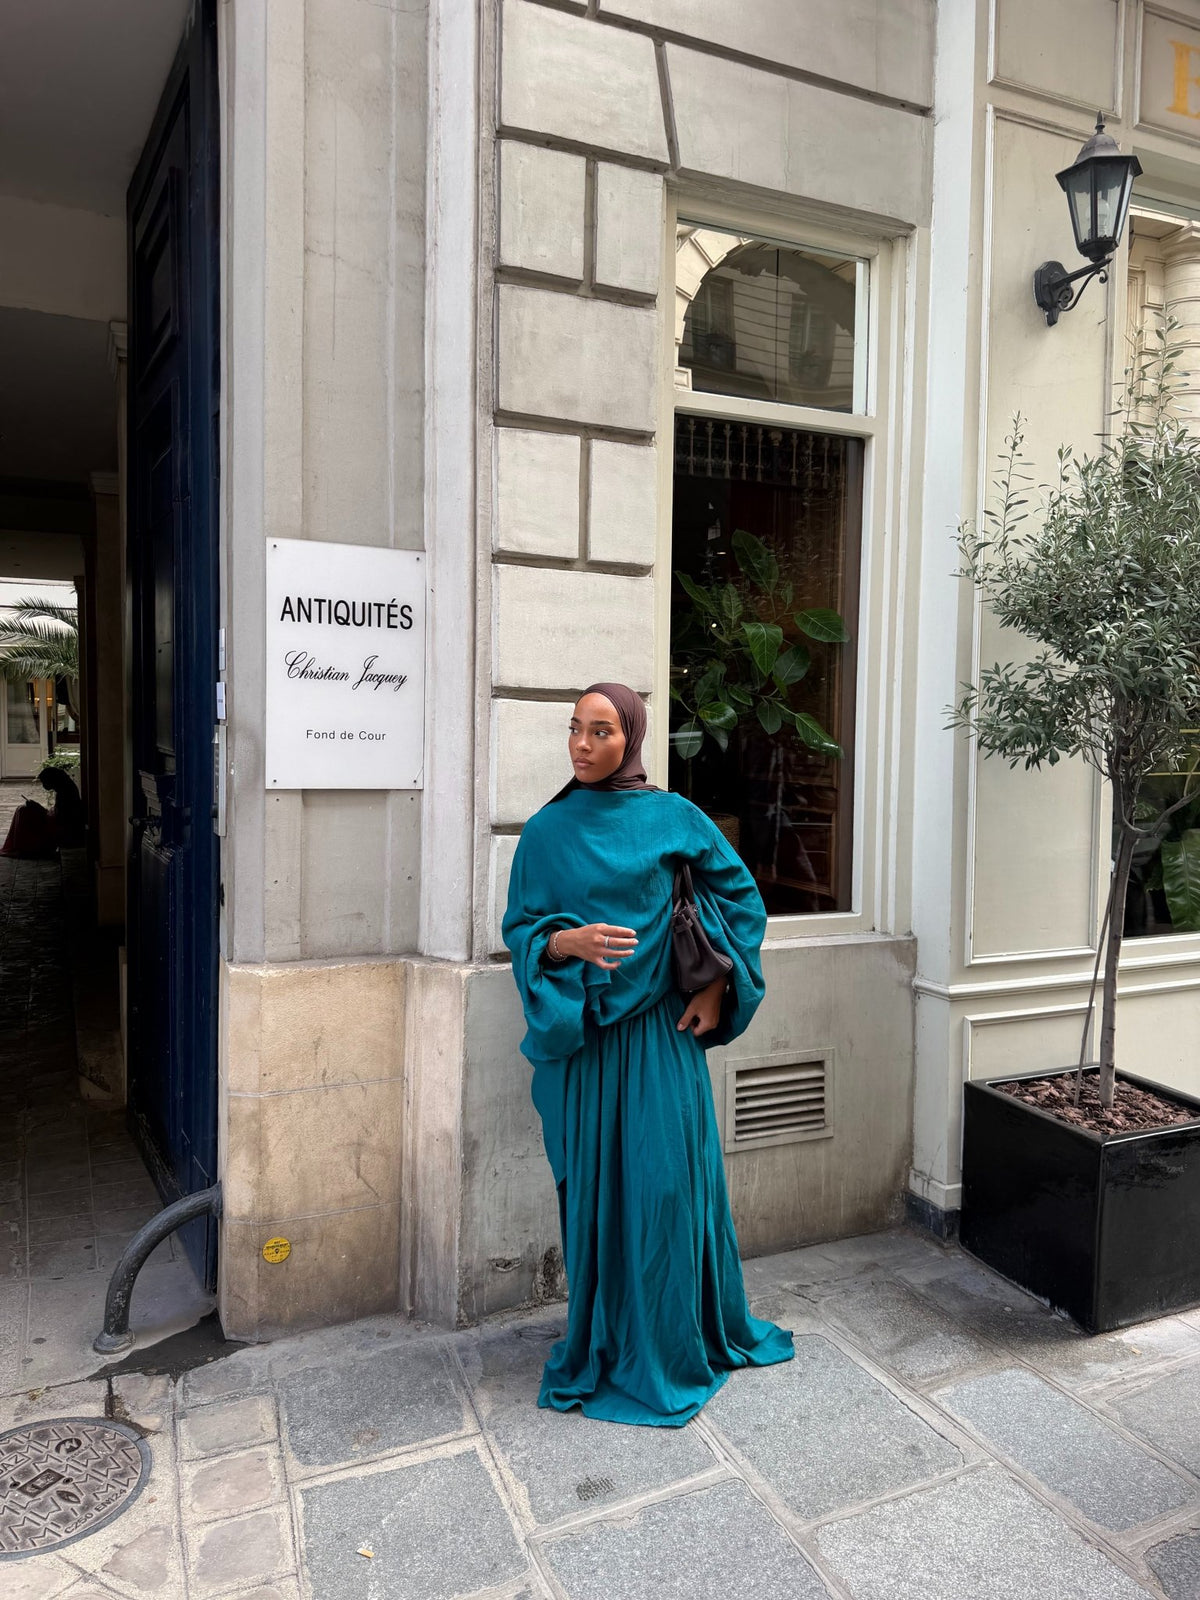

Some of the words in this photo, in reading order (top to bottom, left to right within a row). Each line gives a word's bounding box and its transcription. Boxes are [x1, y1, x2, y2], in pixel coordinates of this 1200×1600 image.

[280, 596, 413, 630] ANTIQUITÉS
[285, 651, 350, 681] Christian
[352, 655, 408, 692] Jacquey
[306, 730, 336, 740] Fond
[340, 730, 354, 741] de
[358, 730, 387, 741] Cour
